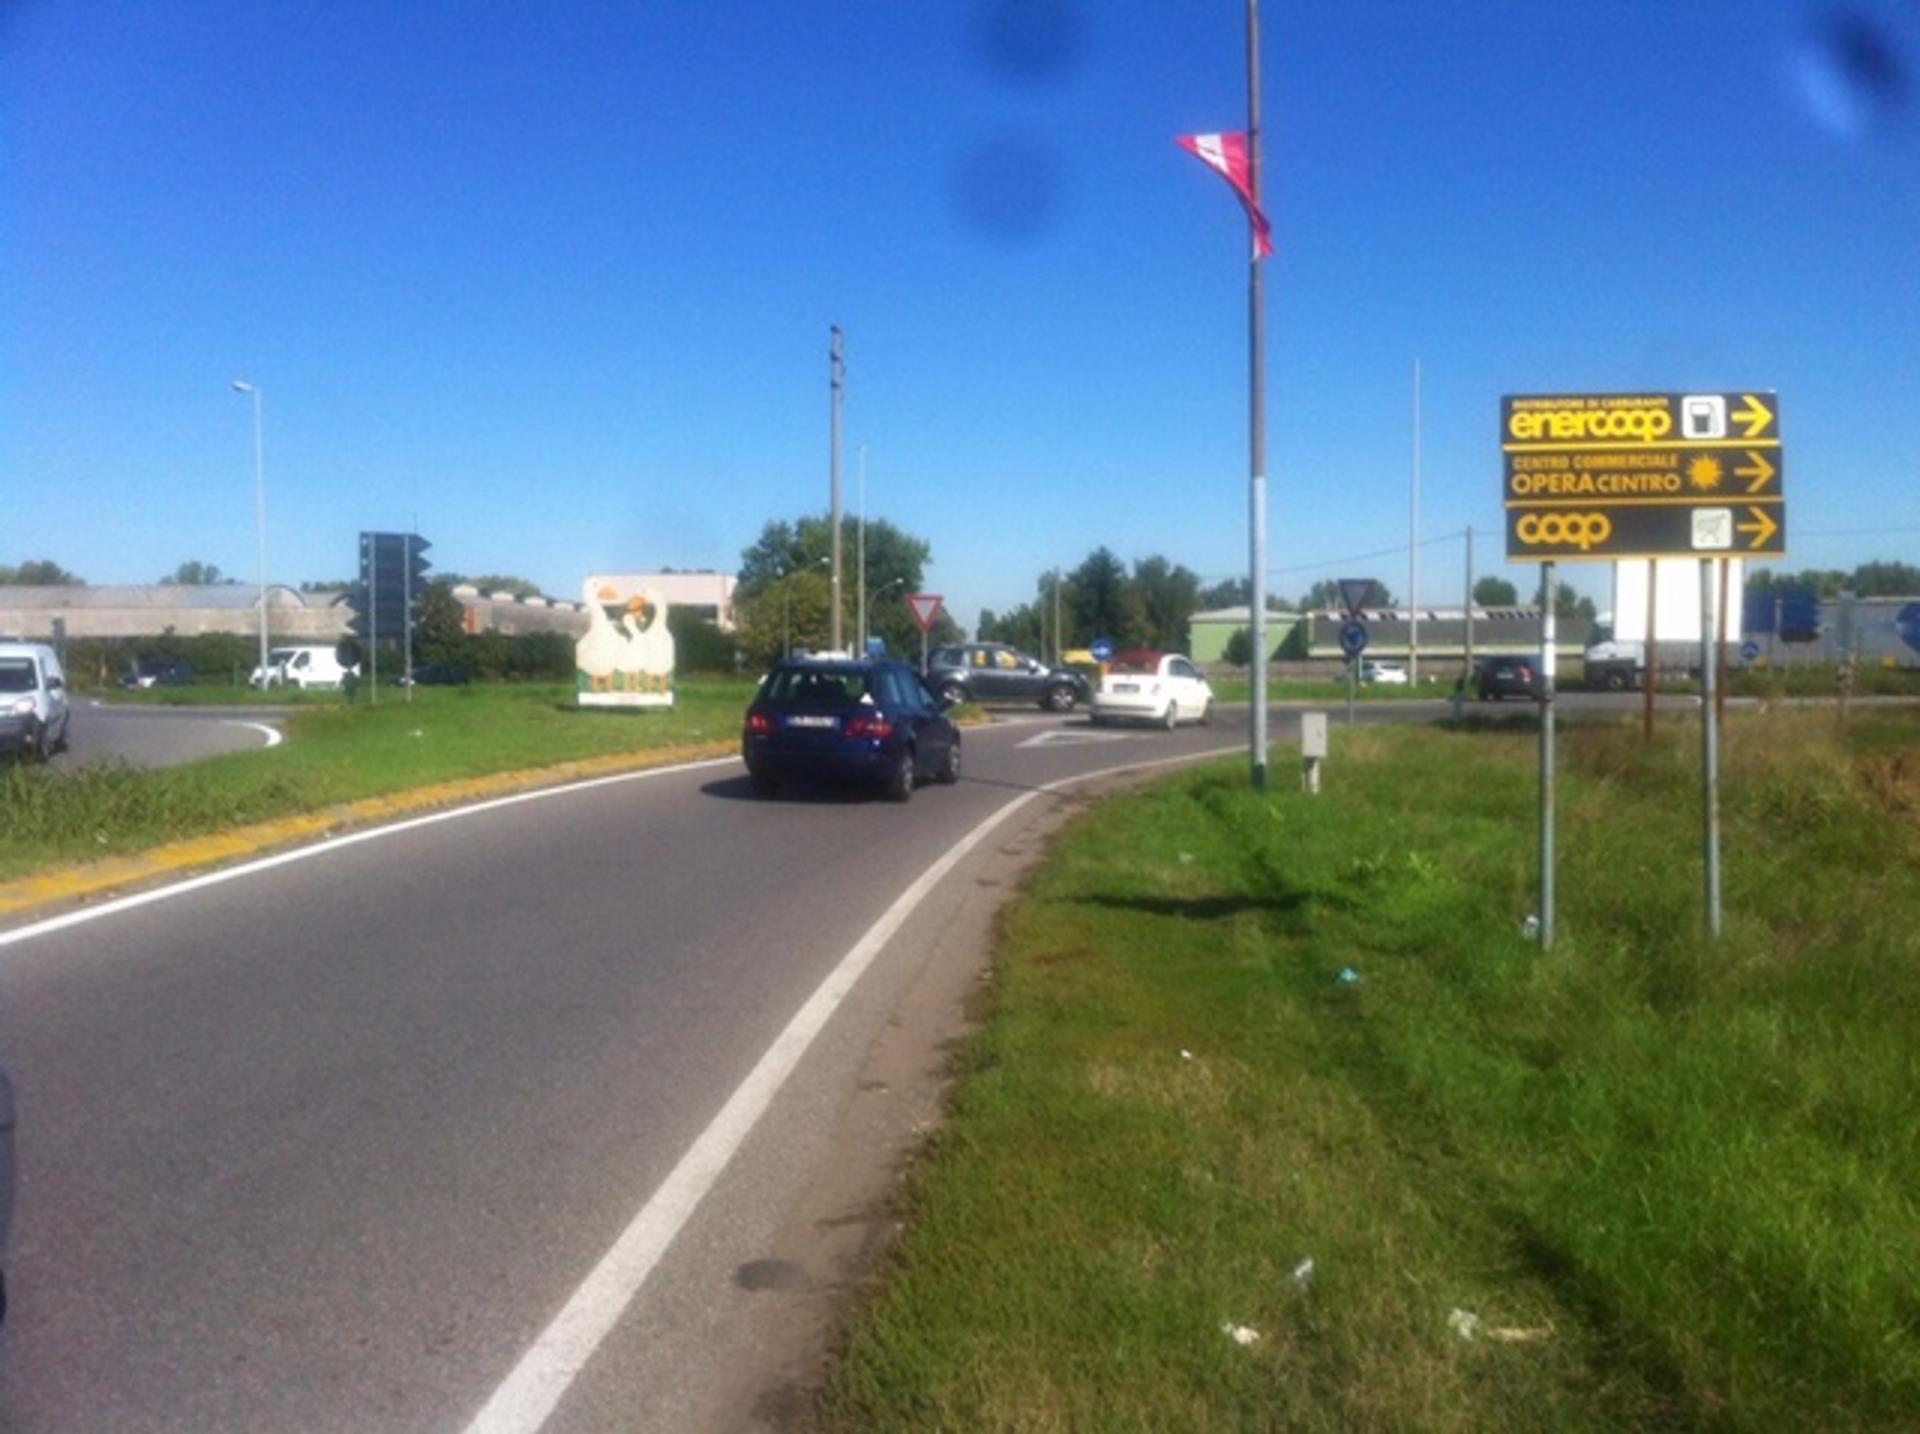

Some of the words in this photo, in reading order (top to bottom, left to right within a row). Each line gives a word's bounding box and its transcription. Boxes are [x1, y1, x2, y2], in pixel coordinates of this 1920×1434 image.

[1510, 409, 1672, 441] enercoop
[1513, 457, 1570, 470] CENTRO
[1574, 454, 1678, 469] COMMERCIALE
[1516, 513, 1611, 549] coop
